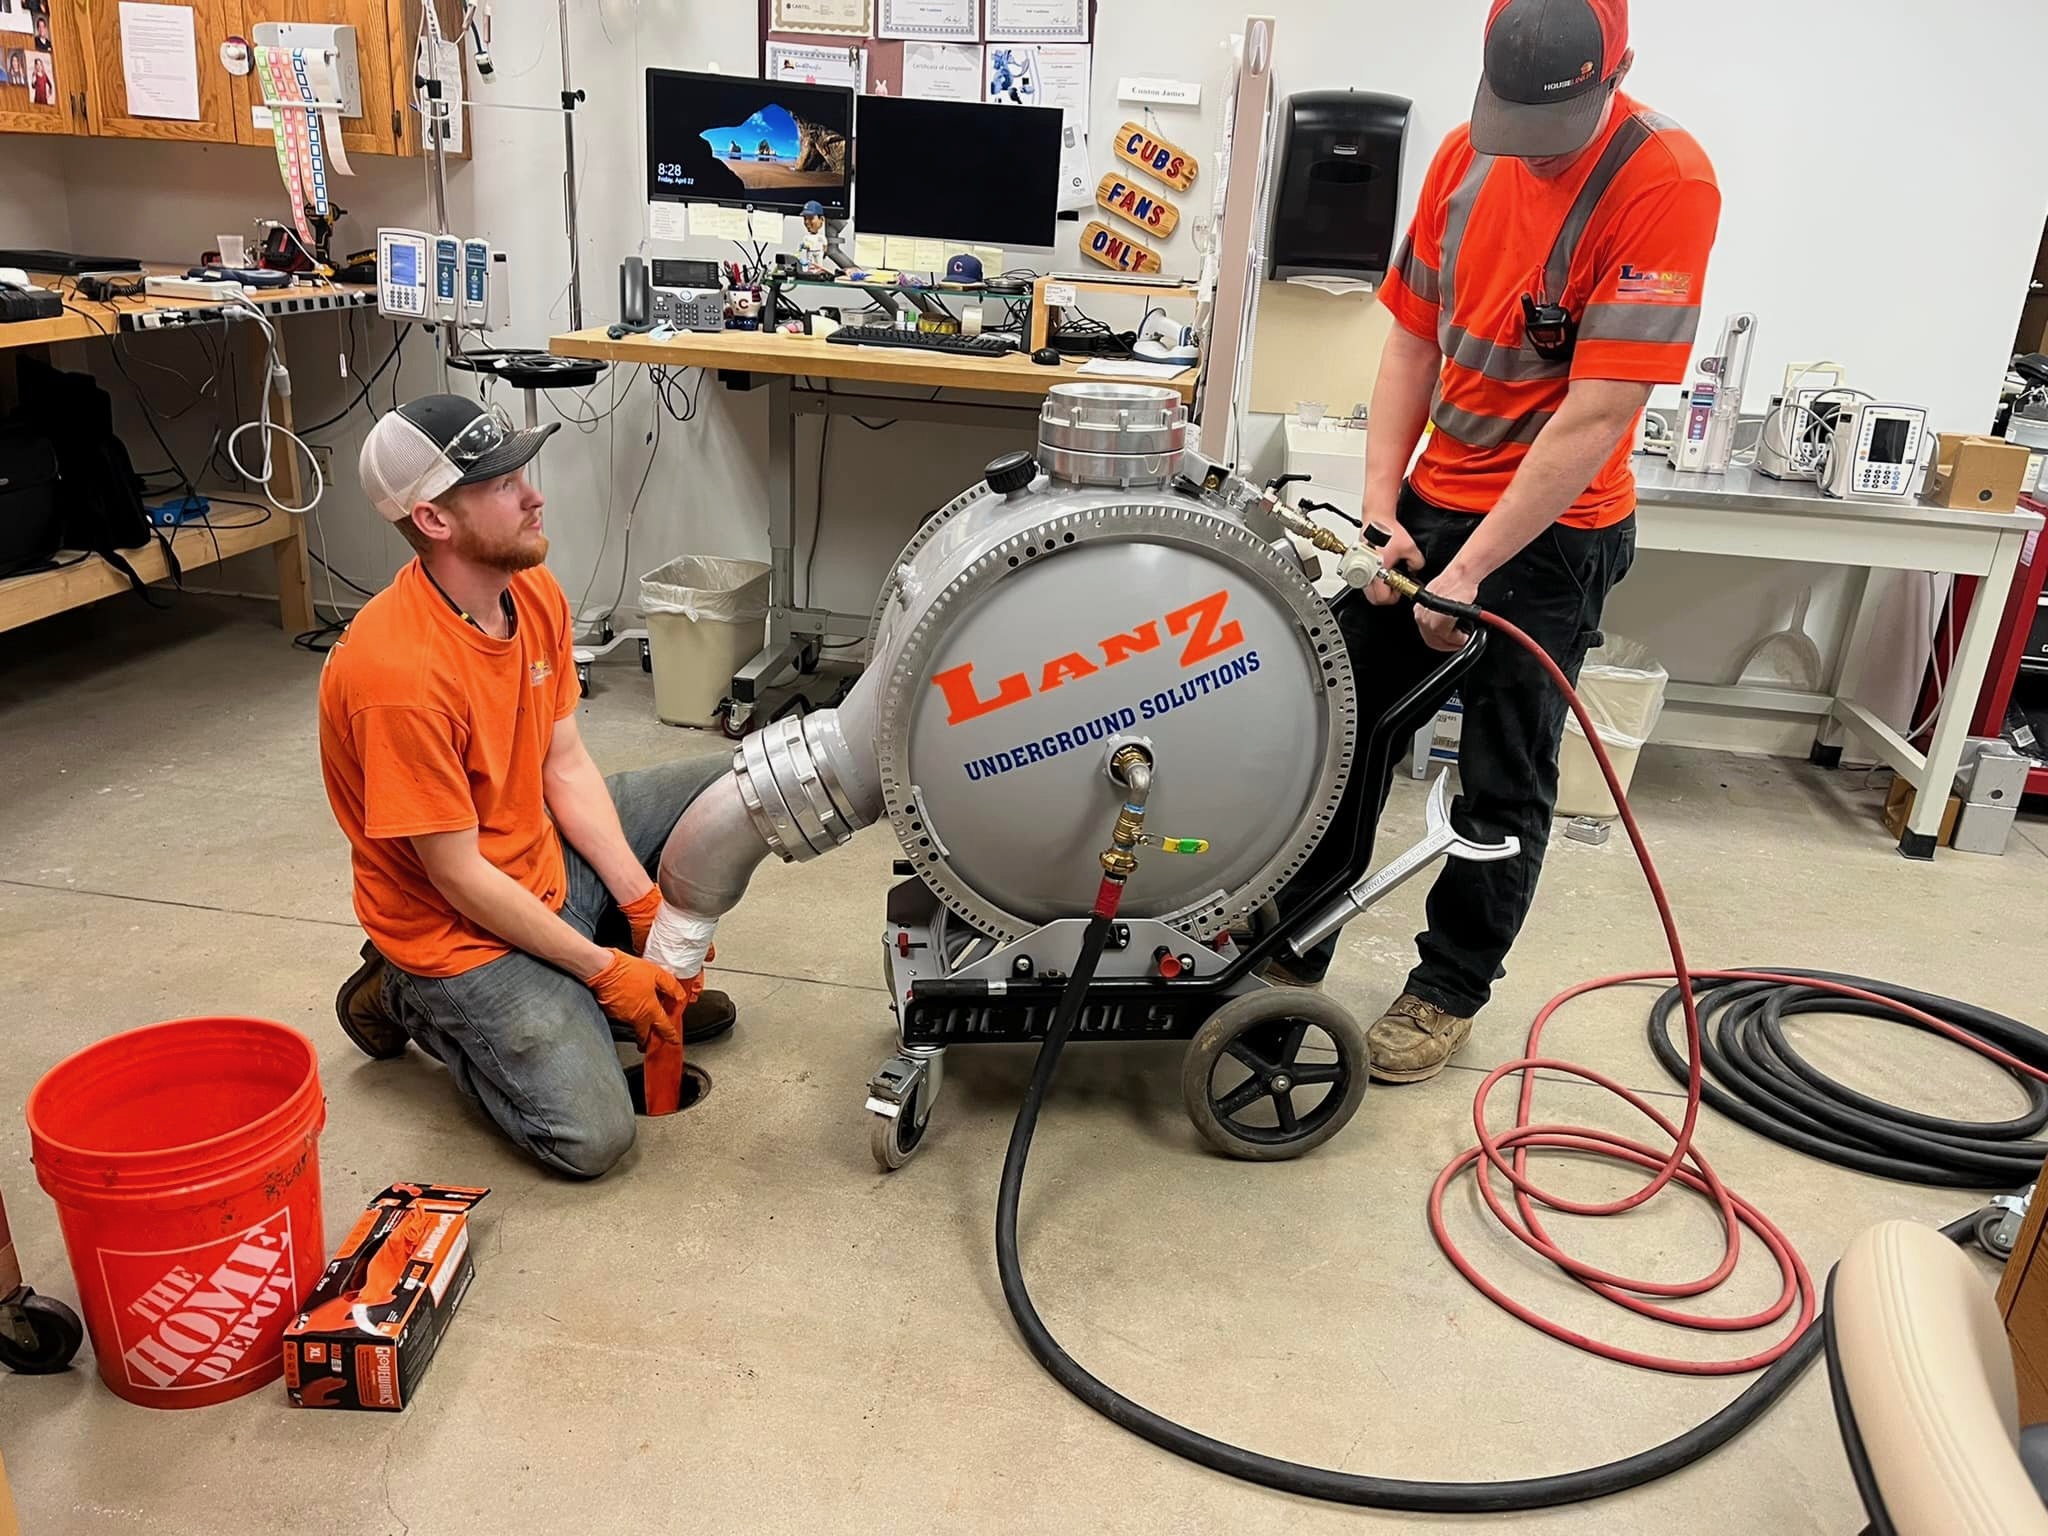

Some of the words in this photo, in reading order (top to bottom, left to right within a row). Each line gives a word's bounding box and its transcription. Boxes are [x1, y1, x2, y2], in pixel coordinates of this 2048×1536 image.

[658, 163, 682, 176] 8:28
[1126, 133, 1185, 179] CUBS
[674, 177, 687, 185] April
[1107, 182, 1165, 226] FANS
[1092, 230, 1147, 272] ONLY
[1139, 650, 1261, 720] SOLUTIONS
[964, 706, 1137, 781] UNDERGROUND
[125, 1225, 290, 1389] HOME
[126, 1265, 204, 1324] THE
[193, 1267, 293, 1382] DEPOT
[309, 1347, 322, 1359] XL
